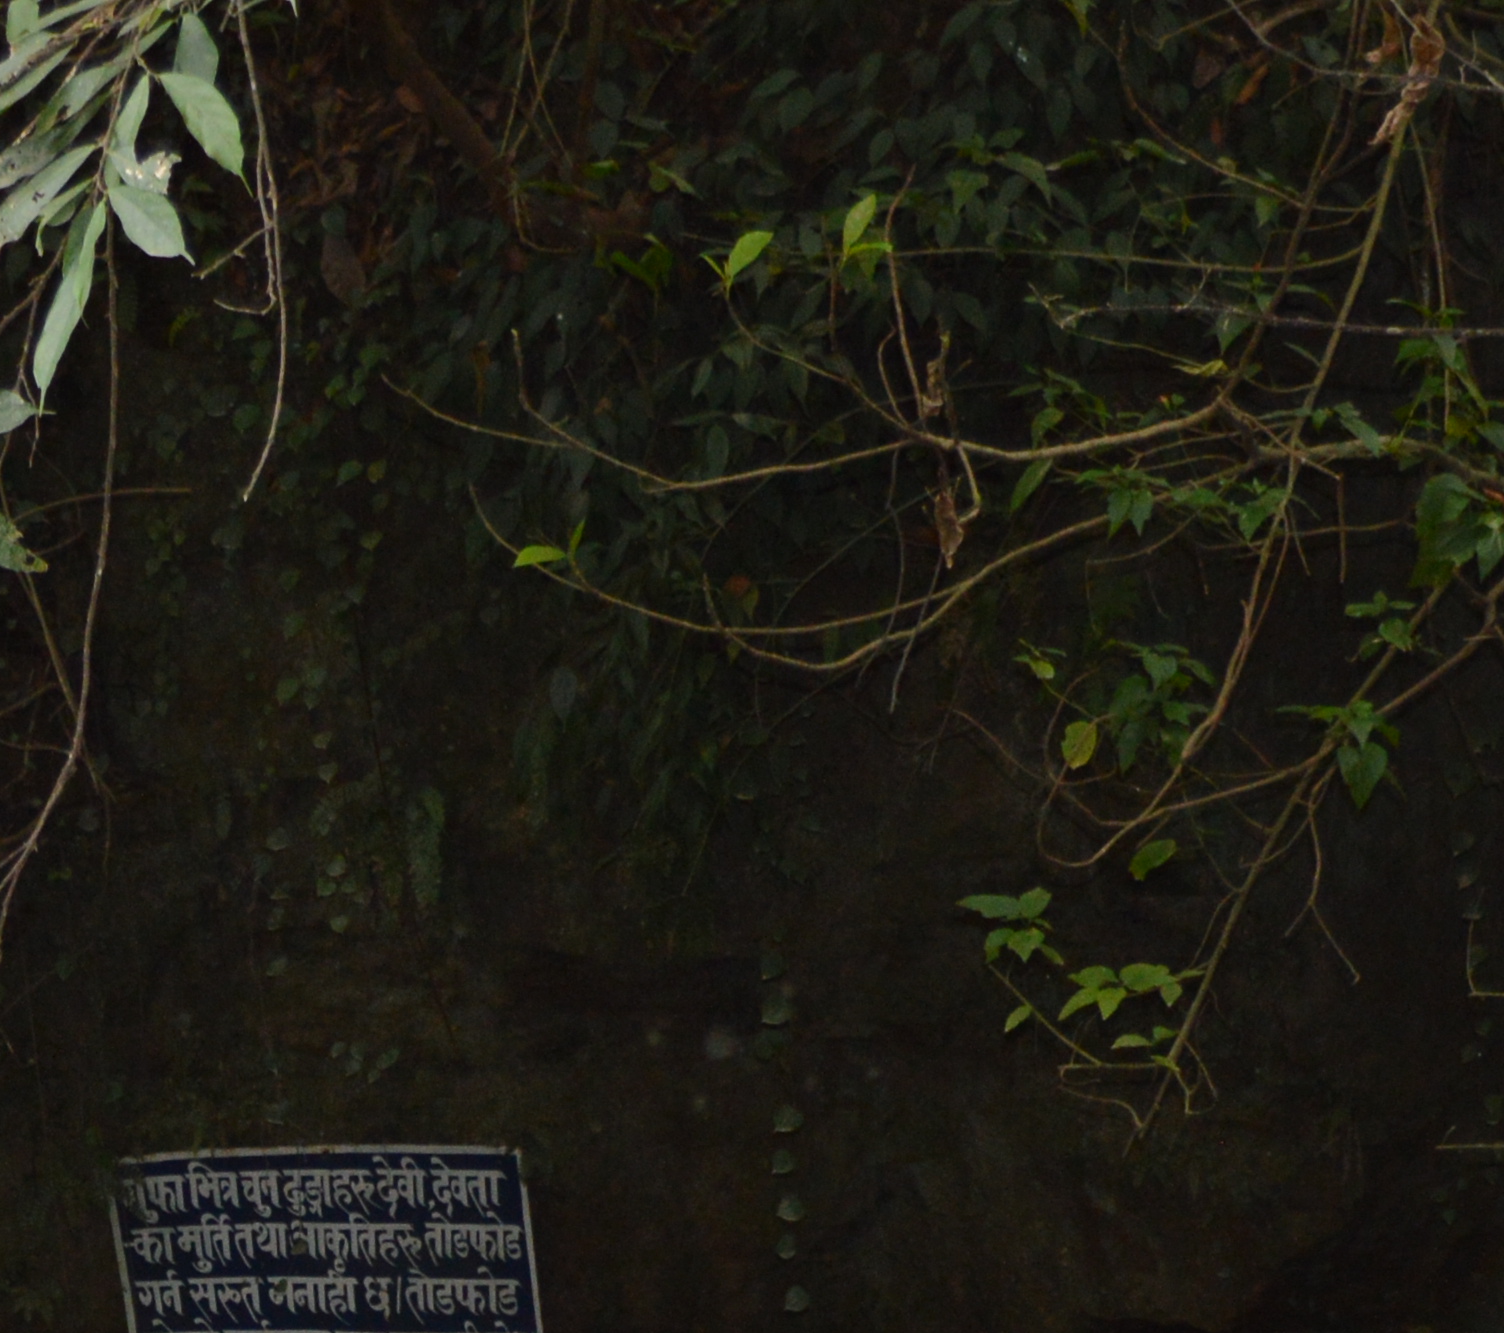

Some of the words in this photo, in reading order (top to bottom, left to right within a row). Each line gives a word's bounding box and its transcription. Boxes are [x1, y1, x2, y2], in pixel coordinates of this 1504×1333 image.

[185, 1161, 240, 1210] भित्र
[234, 1222, 289, 1269] तथा
[424, 1211, 523, 1267] तोडफोड
[134, 1269, 186, 1317] गर्न
[405, 1266, 521, 1325] तोडफोड
